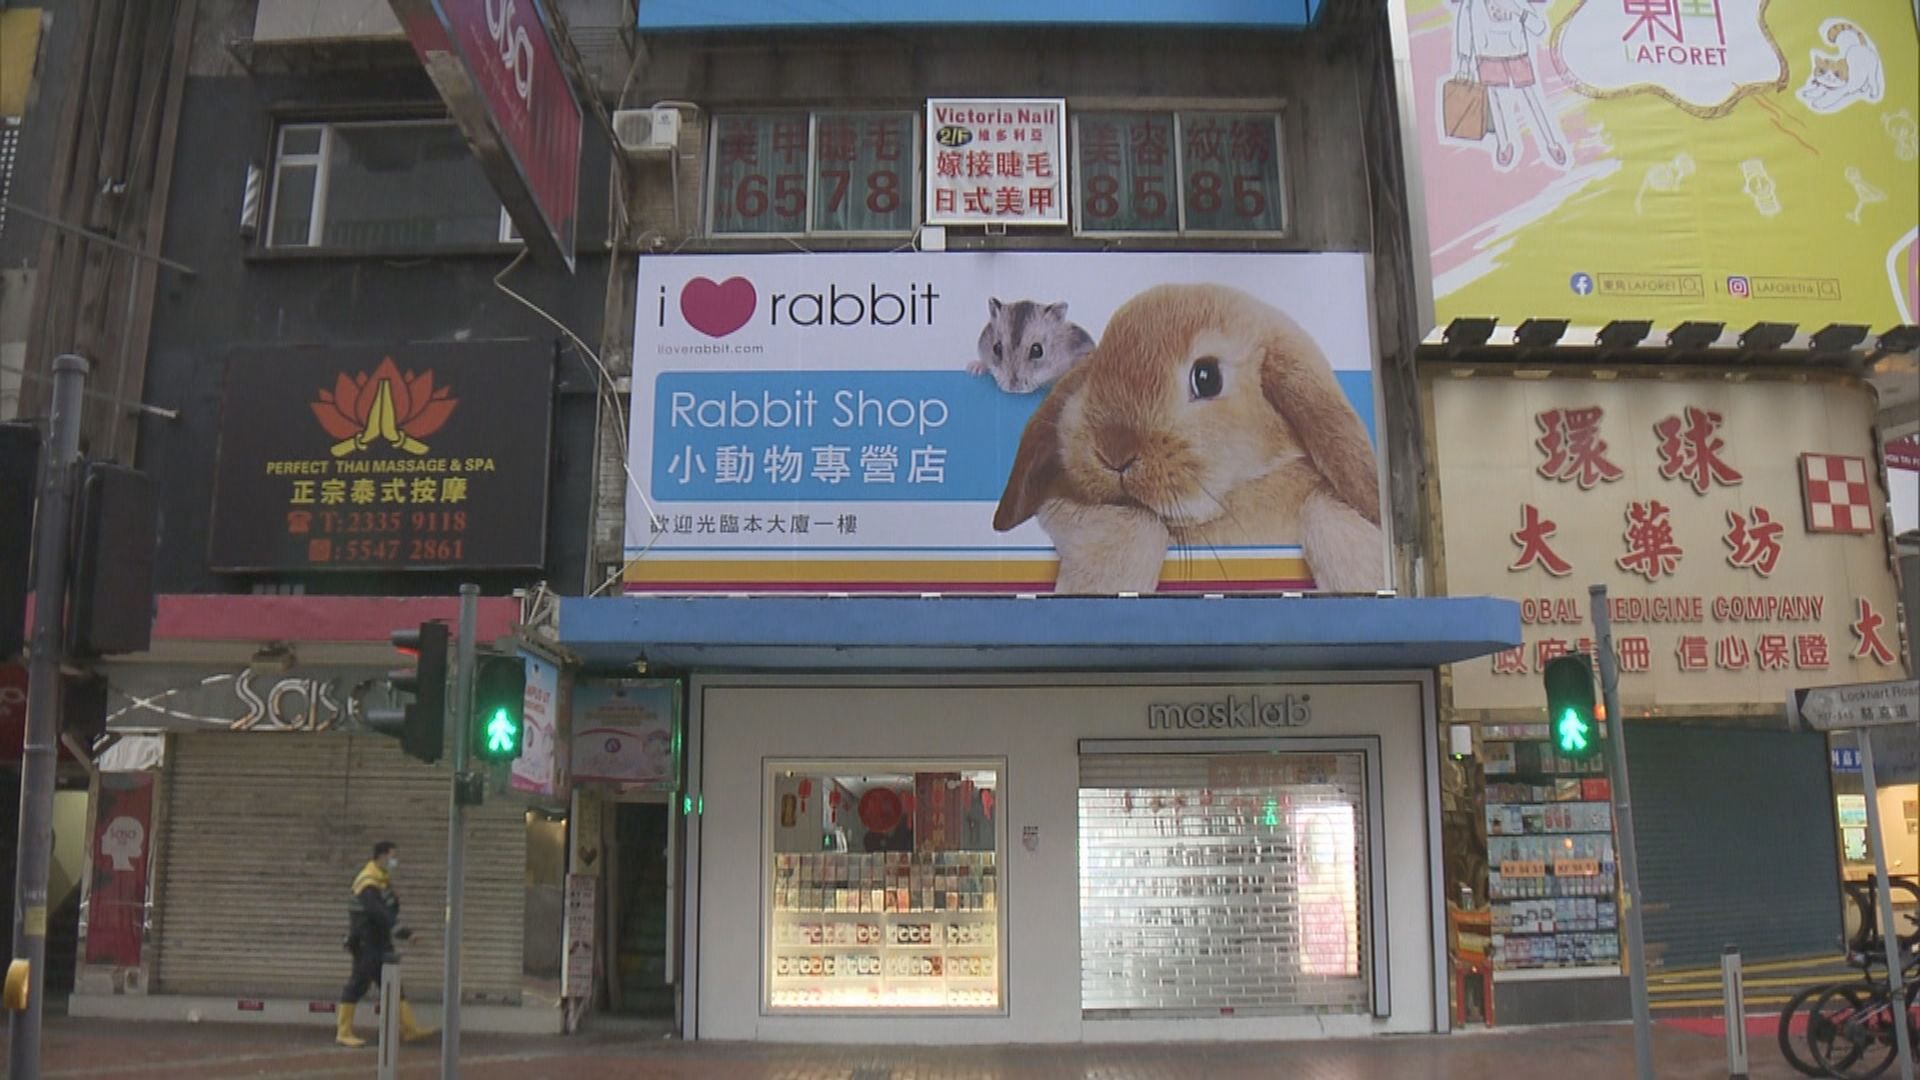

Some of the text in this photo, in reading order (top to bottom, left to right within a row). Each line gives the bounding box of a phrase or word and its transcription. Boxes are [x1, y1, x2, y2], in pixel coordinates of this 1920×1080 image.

[1625, 43, 1727, 66] LAFORET
[935, 107, 1054, 125] Victoria Nail
[940, 128, 969, 145] 2/F
[936, 150, 1054, 178] 嫁接睫毛
[935, 186, 1054, 214] 日式美甲
[658, 283, 940, 327] i rabbit
[671, 389, 949, 435] Rabbit Shop
[1535, 405, 1743, 494] 環球
[266, 458, 496, 475] PERFECT THAI MASSAGE & SPA
[667, 445, 947, 485] 小動物專營店
[290, 477, 469, 504] 正宗泰式按摩
[411, 511, 468, 532] 9118
[408, 540, 464, 560] 2861
[1509, 500, 1784, 581] 大藥坊
[1522, 596, 1825, 624] OBAL EDICINE COMPANY
[1677, 634, 1830, 673] 信心保證
[1841, 686, 1889, 703] Lockhart
[1148, 694, 1312, 729] masklab
